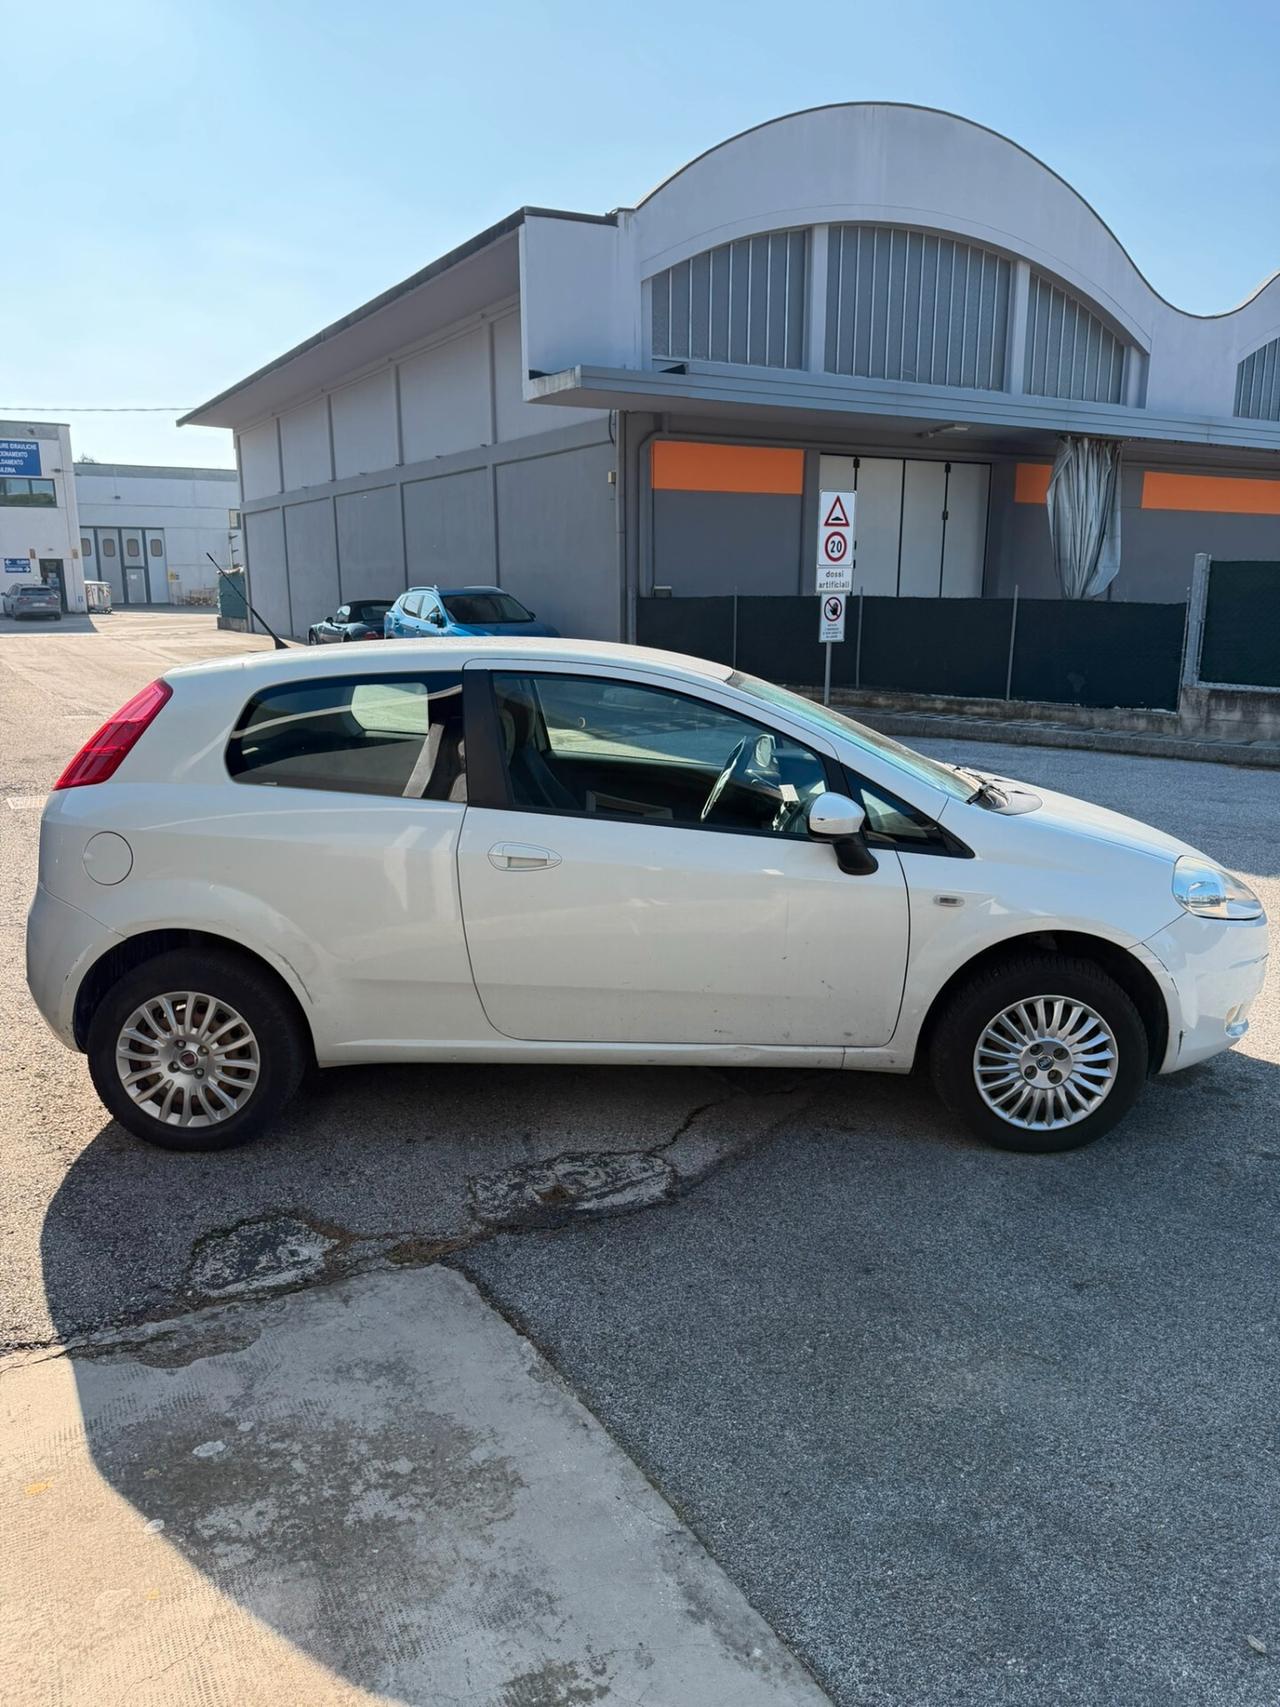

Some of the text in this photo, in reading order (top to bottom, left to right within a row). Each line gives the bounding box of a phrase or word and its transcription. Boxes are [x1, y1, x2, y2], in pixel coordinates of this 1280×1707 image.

[830, 540, 842, 553] 20
[825, 570, 844, 578] dossi
[818, 581, 850, 589] artificiali
